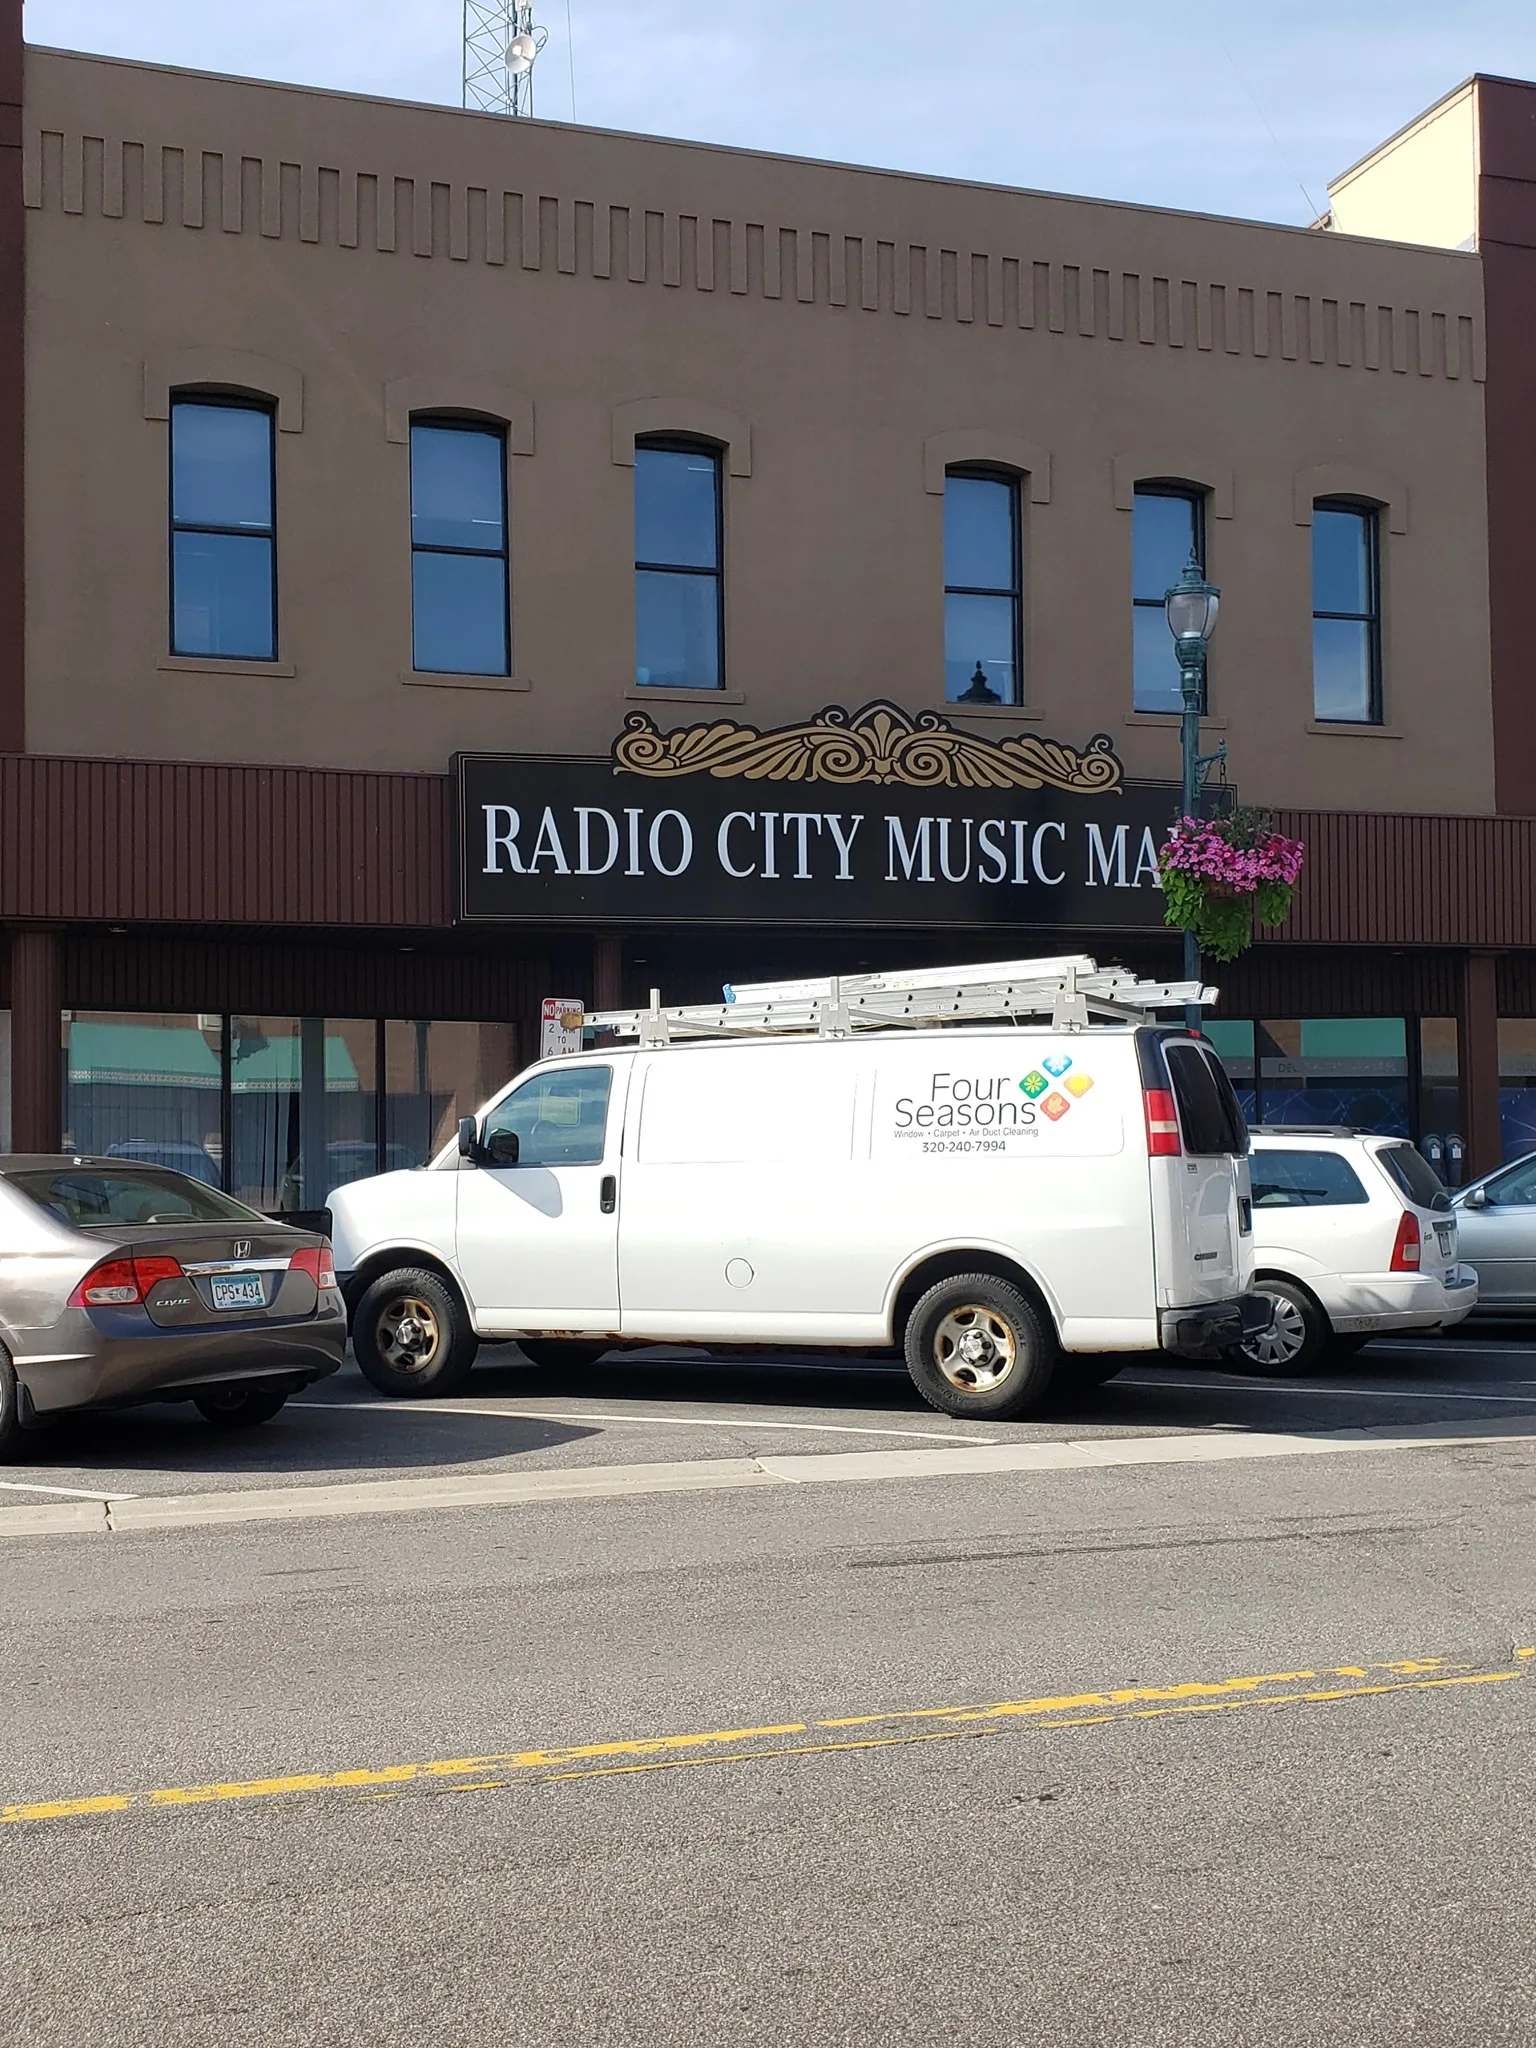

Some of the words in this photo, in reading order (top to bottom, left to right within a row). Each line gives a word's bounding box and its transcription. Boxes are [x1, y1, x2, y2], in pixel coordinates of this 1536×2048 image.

[482, 804, 693, 876] RADIO
[717, 811, 864, 879] CITY
[884, 816, 1066, 885] MUSIC
[1084, 823, 1181, 889] MA
[544, 1003, 555, 1017] NO
[549, 1023, 555, 1034] 2
[557, 1036, 567, 1044] TO
[548, 1046, 554, 1056] 6
[561, 1047, 575, 1055] AM
[931, 1072, 1011, 1102] Four
[895, 1098, 1036, 1127] Seasons
[893, 1129, 925, 1138] Window
[933, 1129, 960, 1139] Carpet
[969, 1128, 980, 1137] Air
[982, 1127, 1001, 1137] Duct
[1002, 1126, 1039, 1138] Cleaning
[922, 1140, 1007, 1153] 320-240-7994
[214, 1284, 236, 1301] CPS
[242, 1282, 261, 1299] 434
